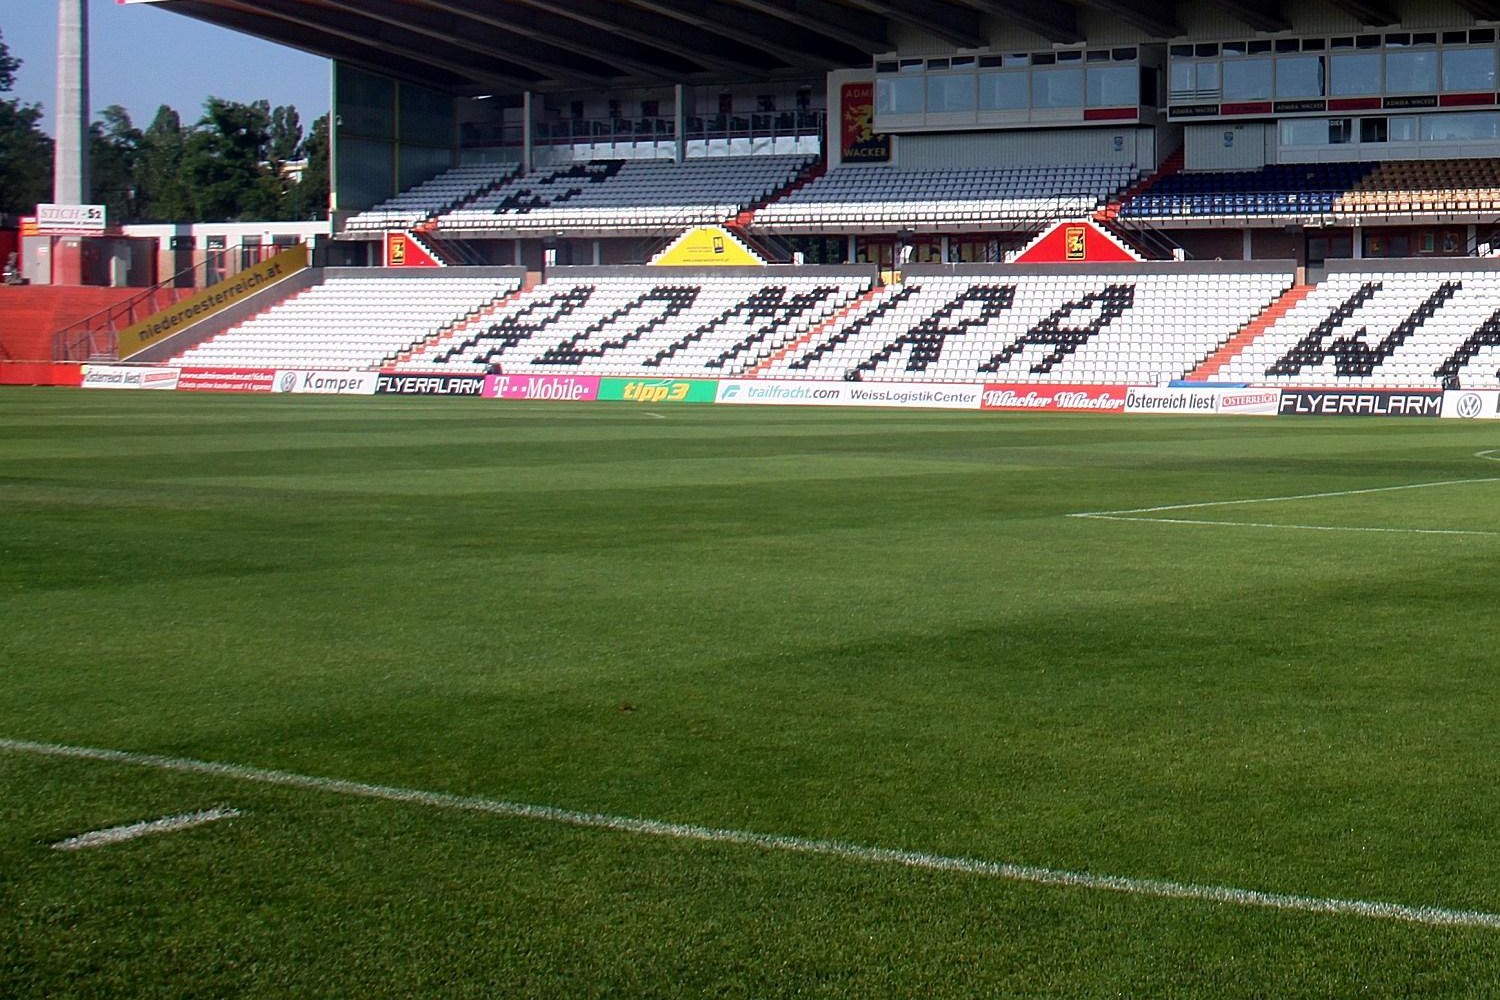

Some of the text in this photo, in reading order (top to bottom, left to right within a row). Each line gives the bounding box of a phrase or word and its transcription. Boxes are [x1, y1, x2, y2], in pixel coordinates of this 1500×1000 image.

[844, 147, 887, 158] WACKER
[138, 261, 283, 342] niederoesterreich.at
[303, 372, 364, 394] Kamper
[377, 376, 485, 395] FLYERALARM
[623, 380, 689, 402] tipp3
[748, 384, 840, 401] trailfracht.com
[850, 389, 977, 406] WeissLogistikCenter
[1127, 389, 1216, 410] Österreich liest
[1279, 393, 1441, 416] FLYERALARM
